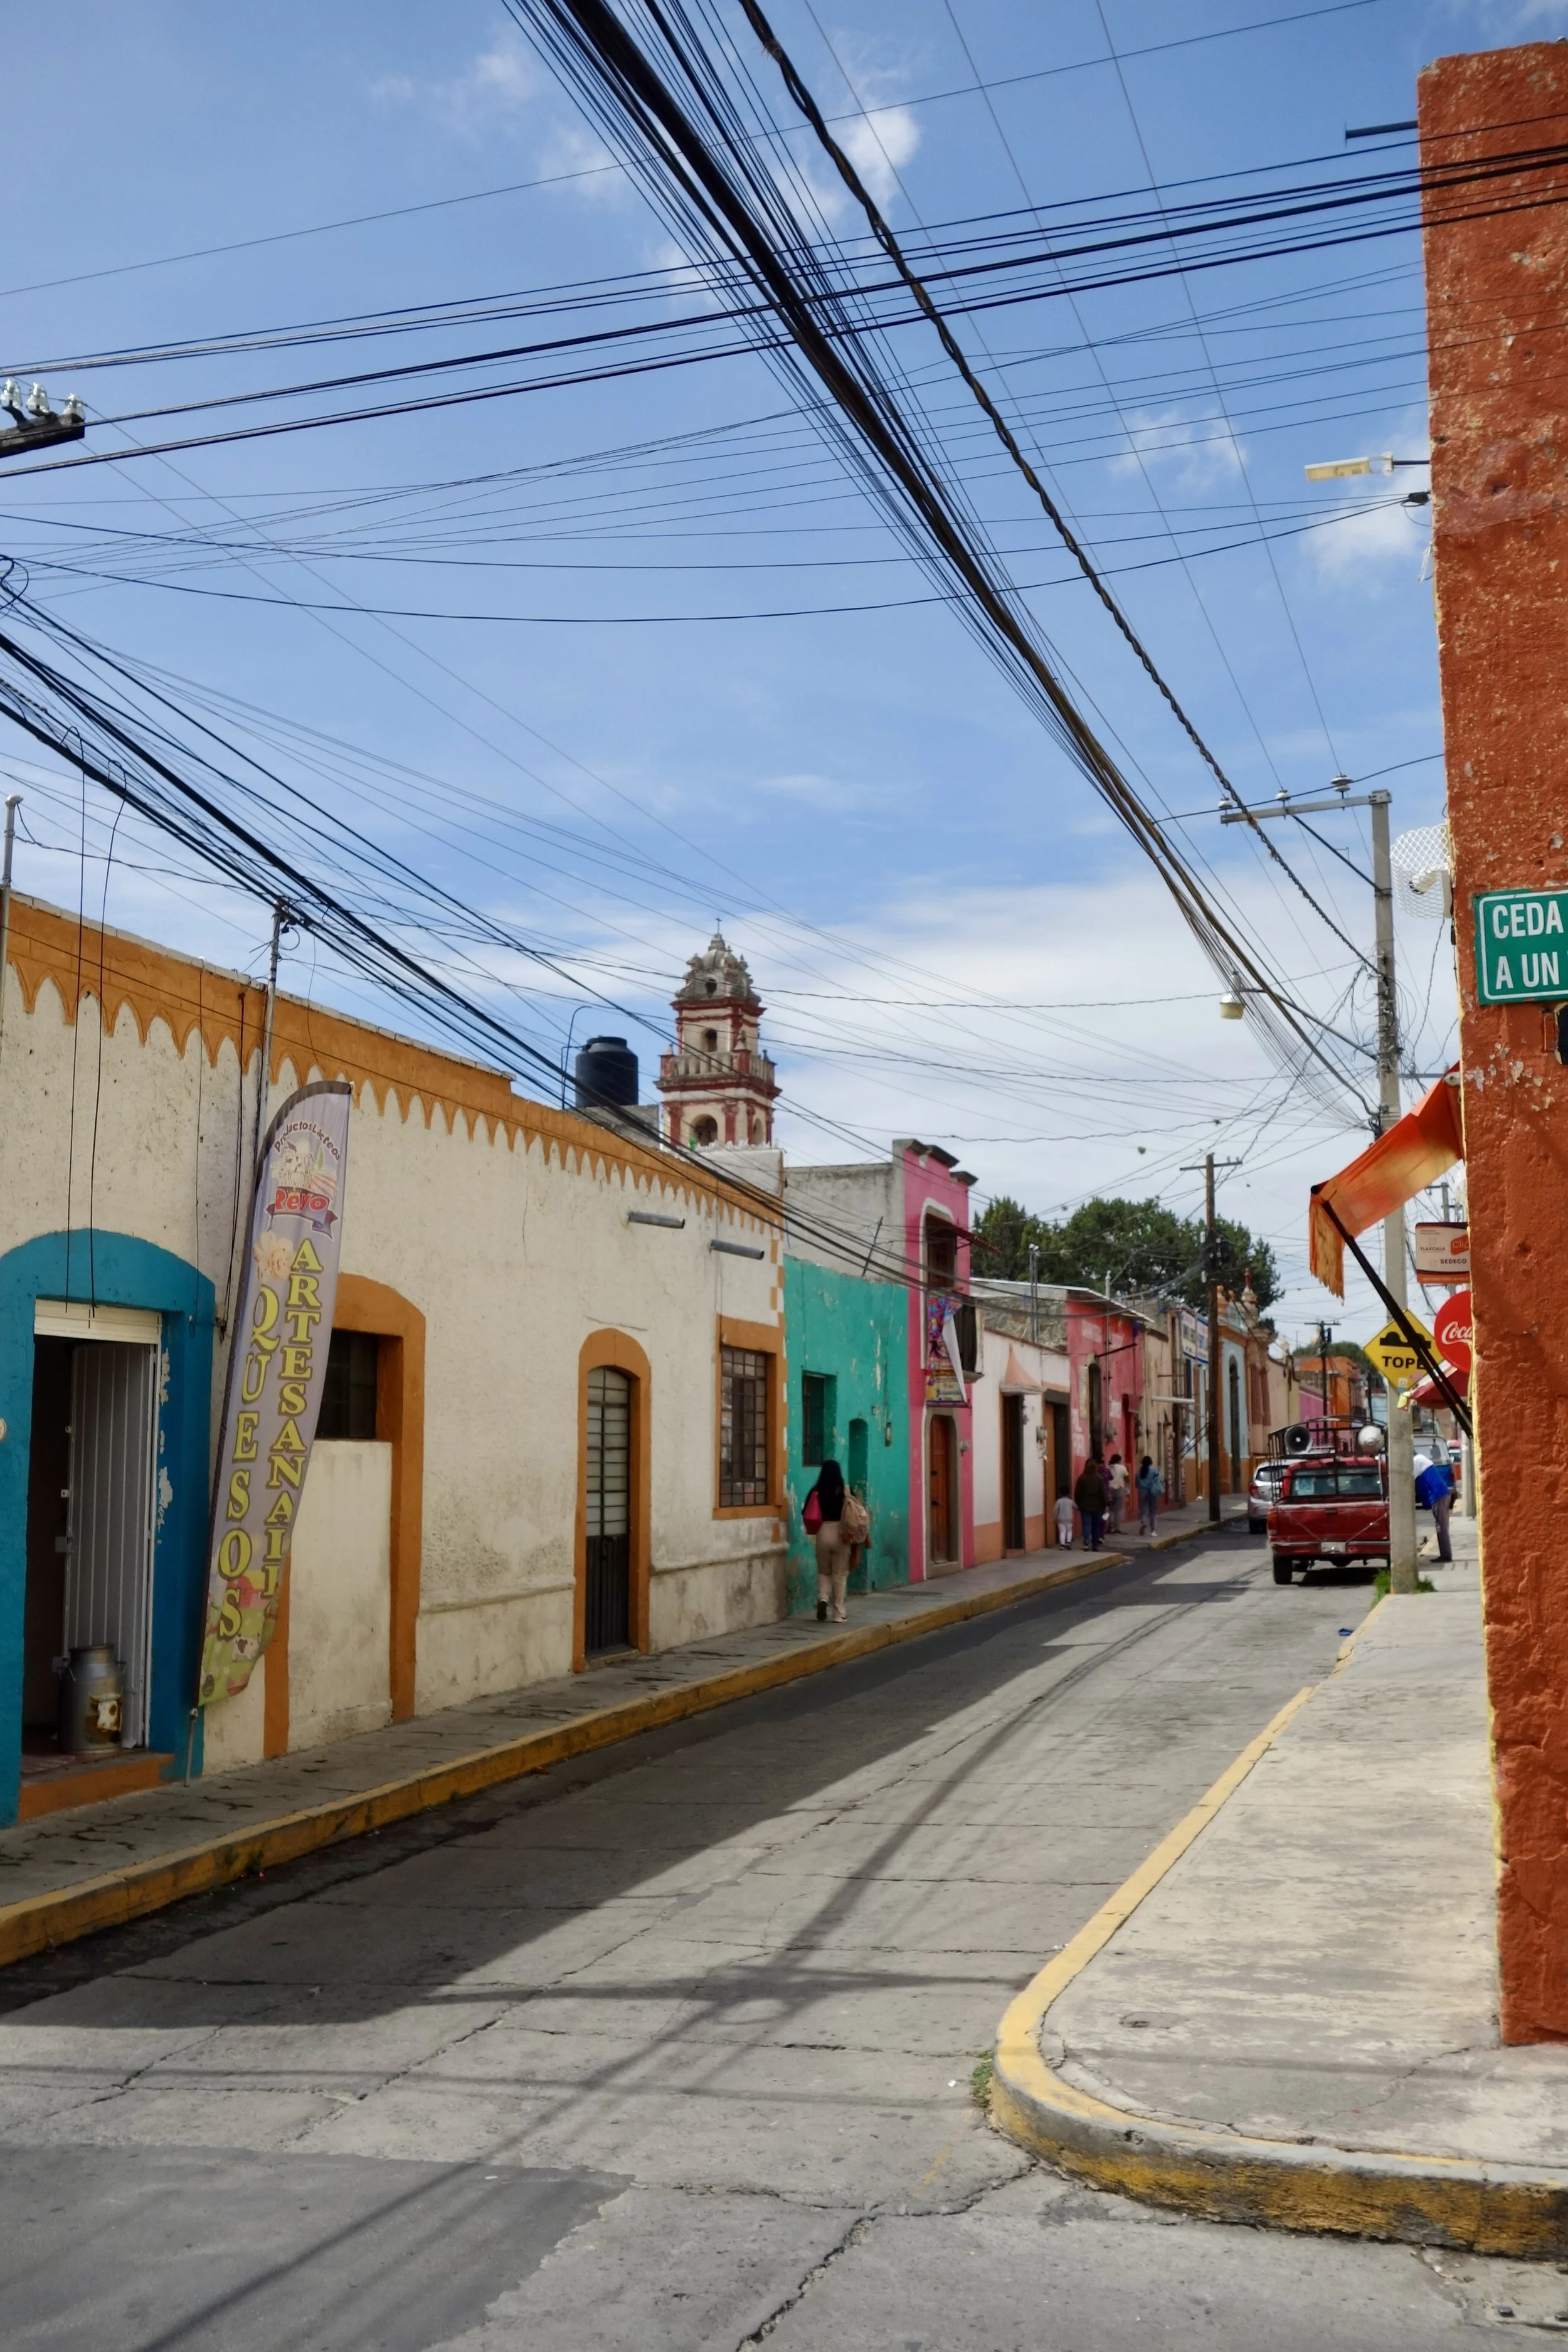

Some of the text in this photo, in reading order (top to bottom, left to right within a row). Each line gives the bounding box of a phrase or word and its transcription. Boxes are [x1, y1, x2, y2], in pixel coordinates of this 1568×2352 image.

[1493, 901, 1564, 939] CEDA
[1495, 951, 1560, 990] A UN
[275, 1189, 328, 1212] Reyo
[217, 1285, 280, 1641] QUESOS
